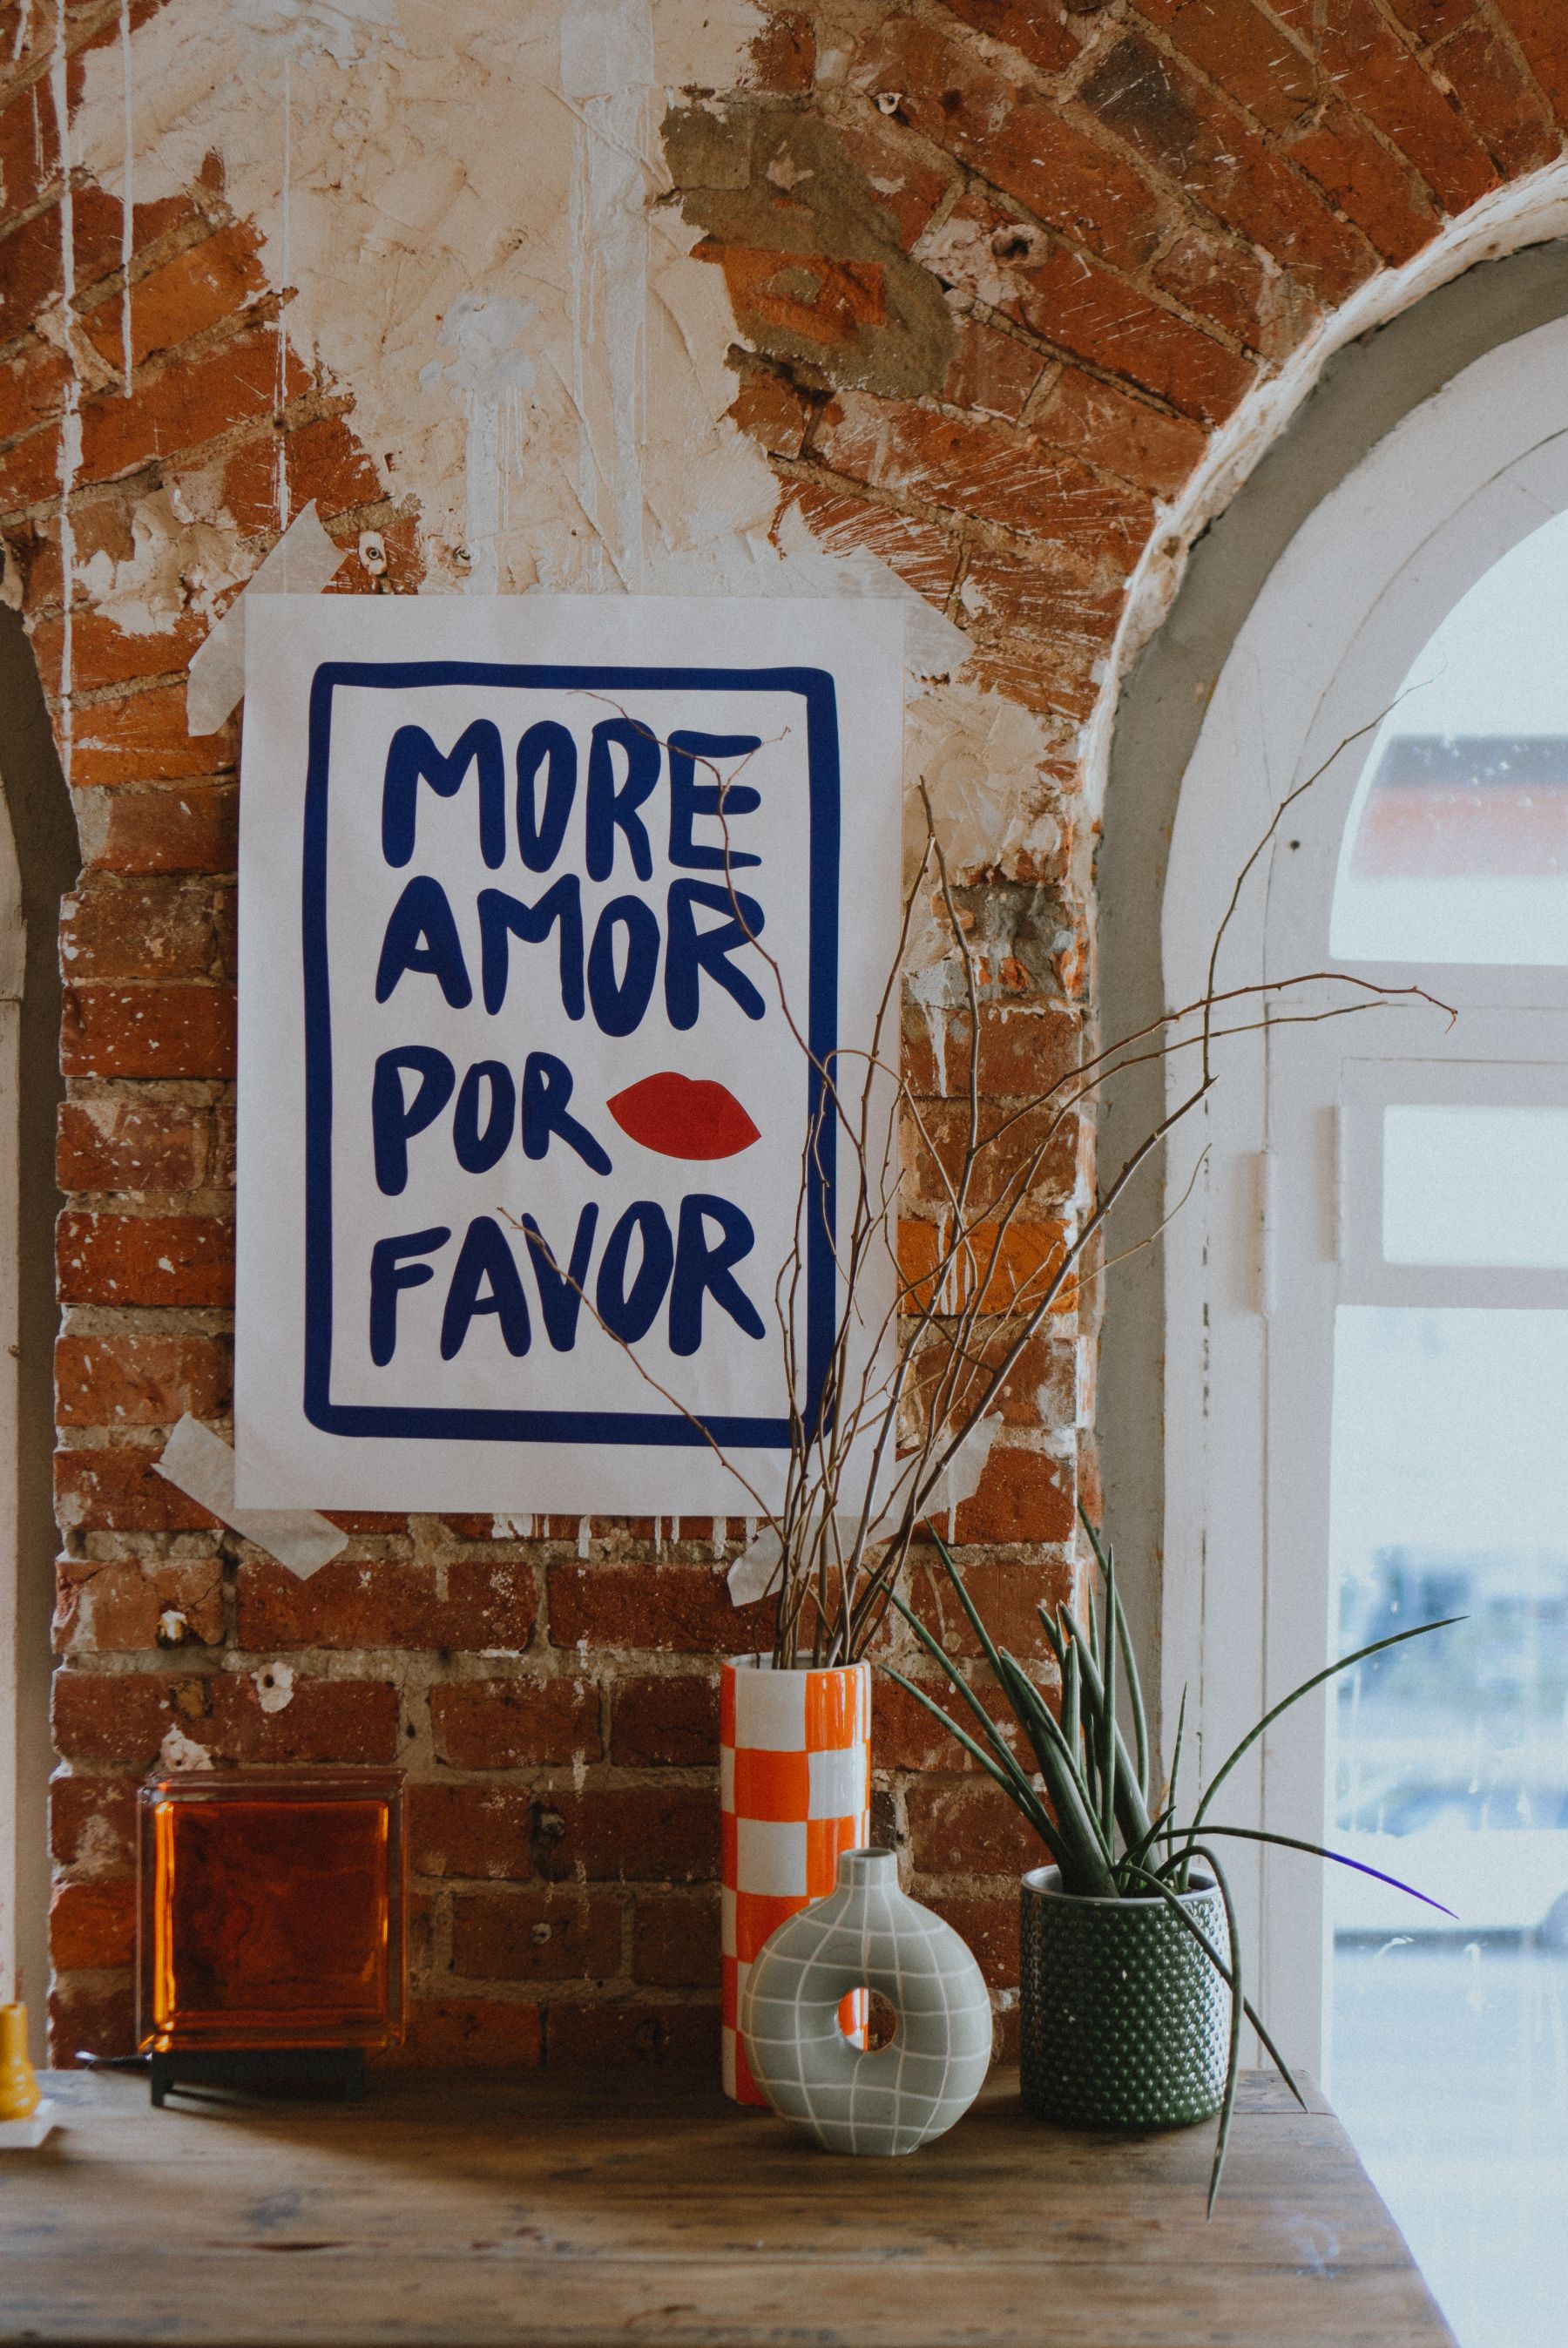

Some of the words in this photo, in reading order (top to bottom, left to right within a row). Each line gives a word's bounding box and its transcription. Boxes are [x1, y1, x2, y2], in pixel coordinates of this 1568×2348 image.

[382, 717, 763, 883] MORE
[375, 873, 767, 1038] AMOR
[371, 1045, 613, 1196] POR
[369, 1194, 767, 1368] FAVOR
